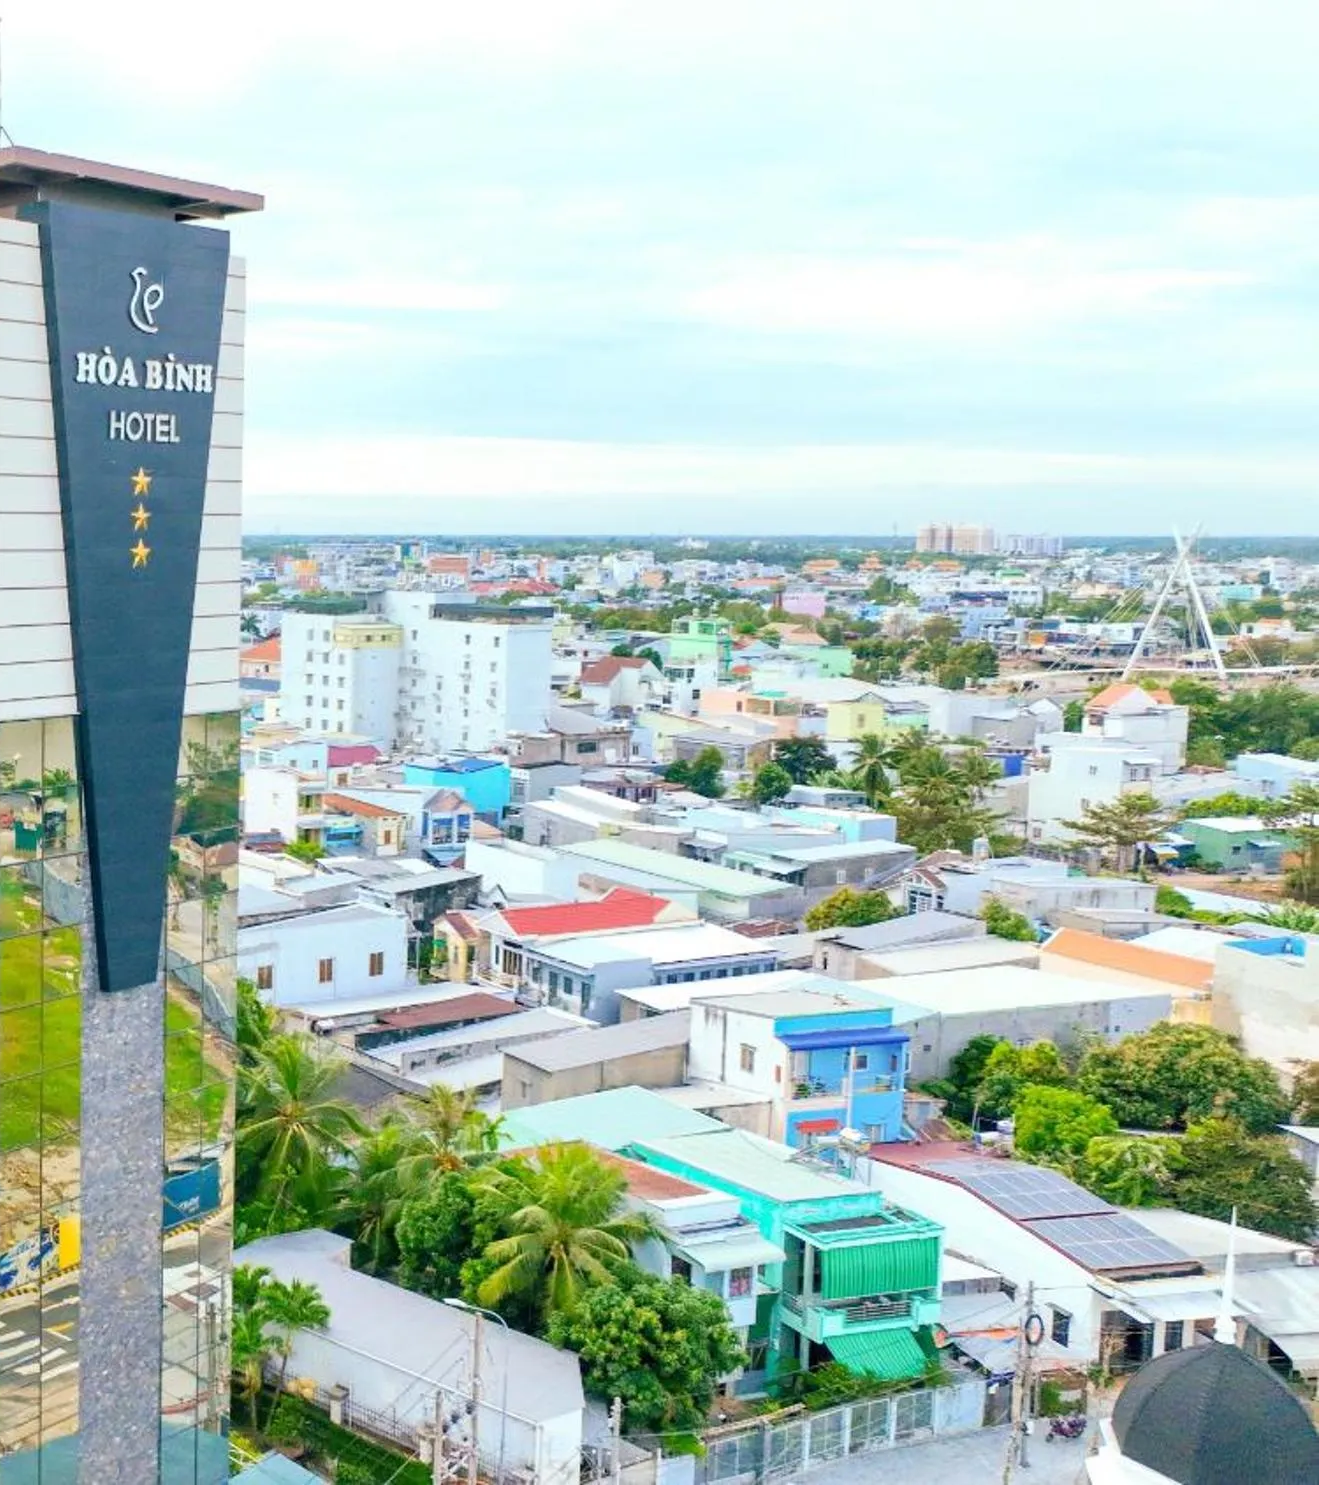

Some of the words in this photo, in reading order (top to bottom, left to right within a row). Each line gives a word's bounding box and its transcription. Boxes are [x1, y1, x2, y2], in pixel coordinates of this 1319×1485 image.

[76, 346, 139, 388] HÒA
[145, 353, 213, 393] BÌNH
[109, 410, 181, 443] HOTEL
